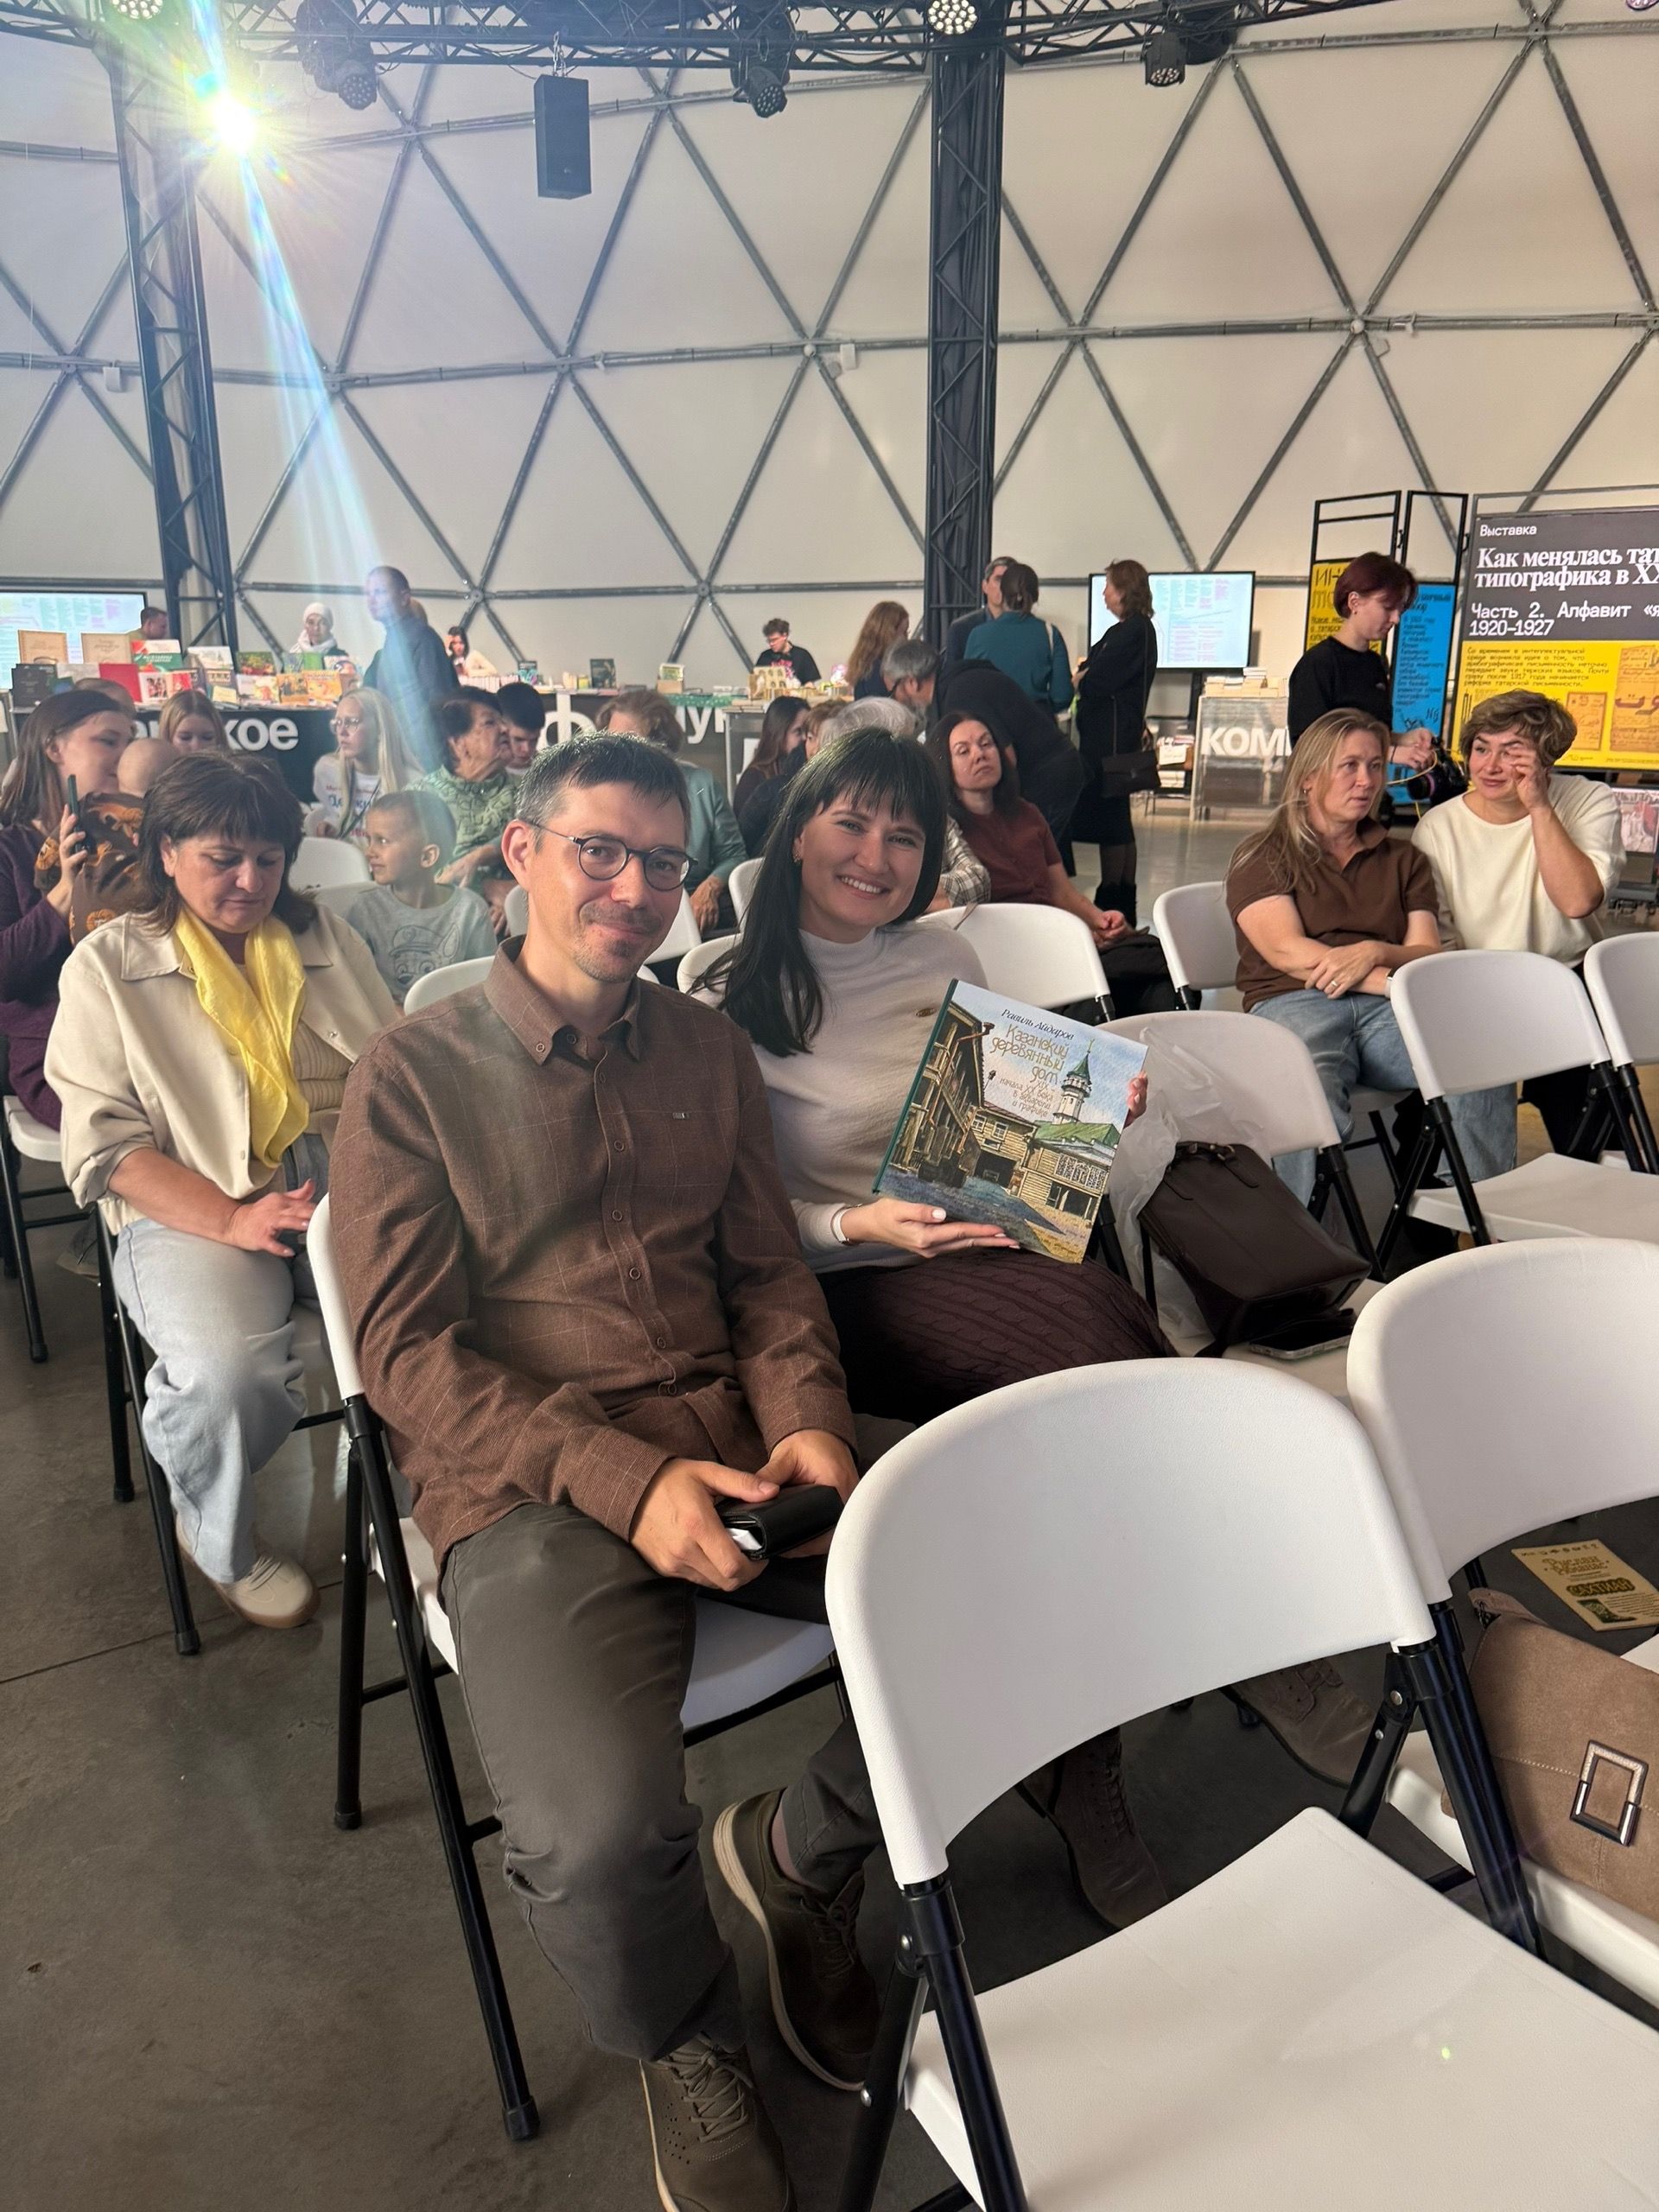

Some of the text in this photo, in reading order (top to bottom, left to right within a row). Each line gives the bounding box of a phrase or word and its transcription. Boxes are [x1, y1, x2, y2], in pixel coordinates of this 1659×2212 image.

[1480, 524, 1537, 537] Выставка
[1477, 547, 1521, 569] Как
[1522, 549, 1623, 568] менялась
[1474, 565, 1611, 592] типографика
[1615, 569, 1630, 585] в
[1471, 602, 1519, 619] Часть
[1529, 601, 1545, 619] 2.
[1556, 600, 1632, 622] Алфавит
[1006, 1024, 1069, 1060] Казанский
[1030, 1066, 1058, 1085] дом
